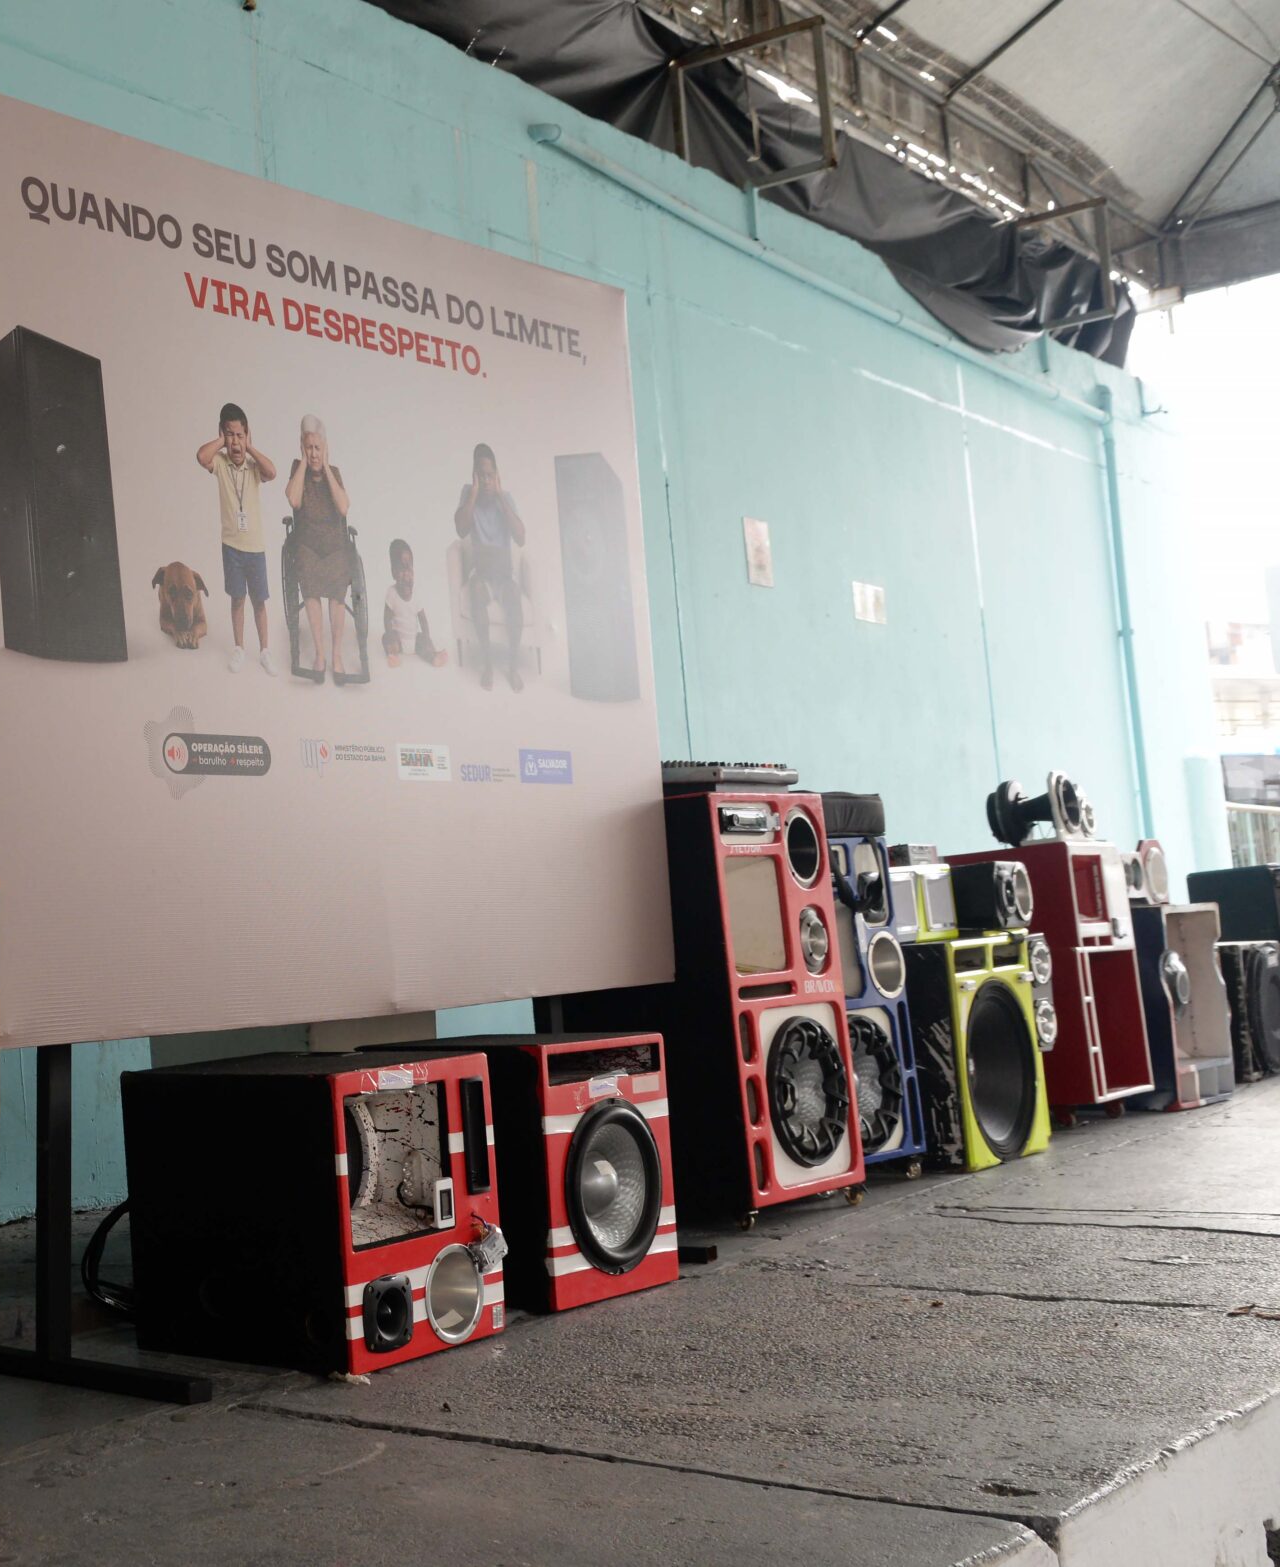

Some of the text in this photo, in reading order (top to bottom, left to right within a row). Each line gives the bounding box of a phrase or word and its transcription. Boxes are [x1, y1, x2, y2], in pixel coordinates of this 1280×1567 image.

[21, 176, 587, 366] QUANDO SEU SOM PASSA DO LIMITE,
[184, 271, 487, 378] VIRA DESRESPEITO.
[199, 756, 227, 766] barulho
[236, 757, 265, 768] respeito
